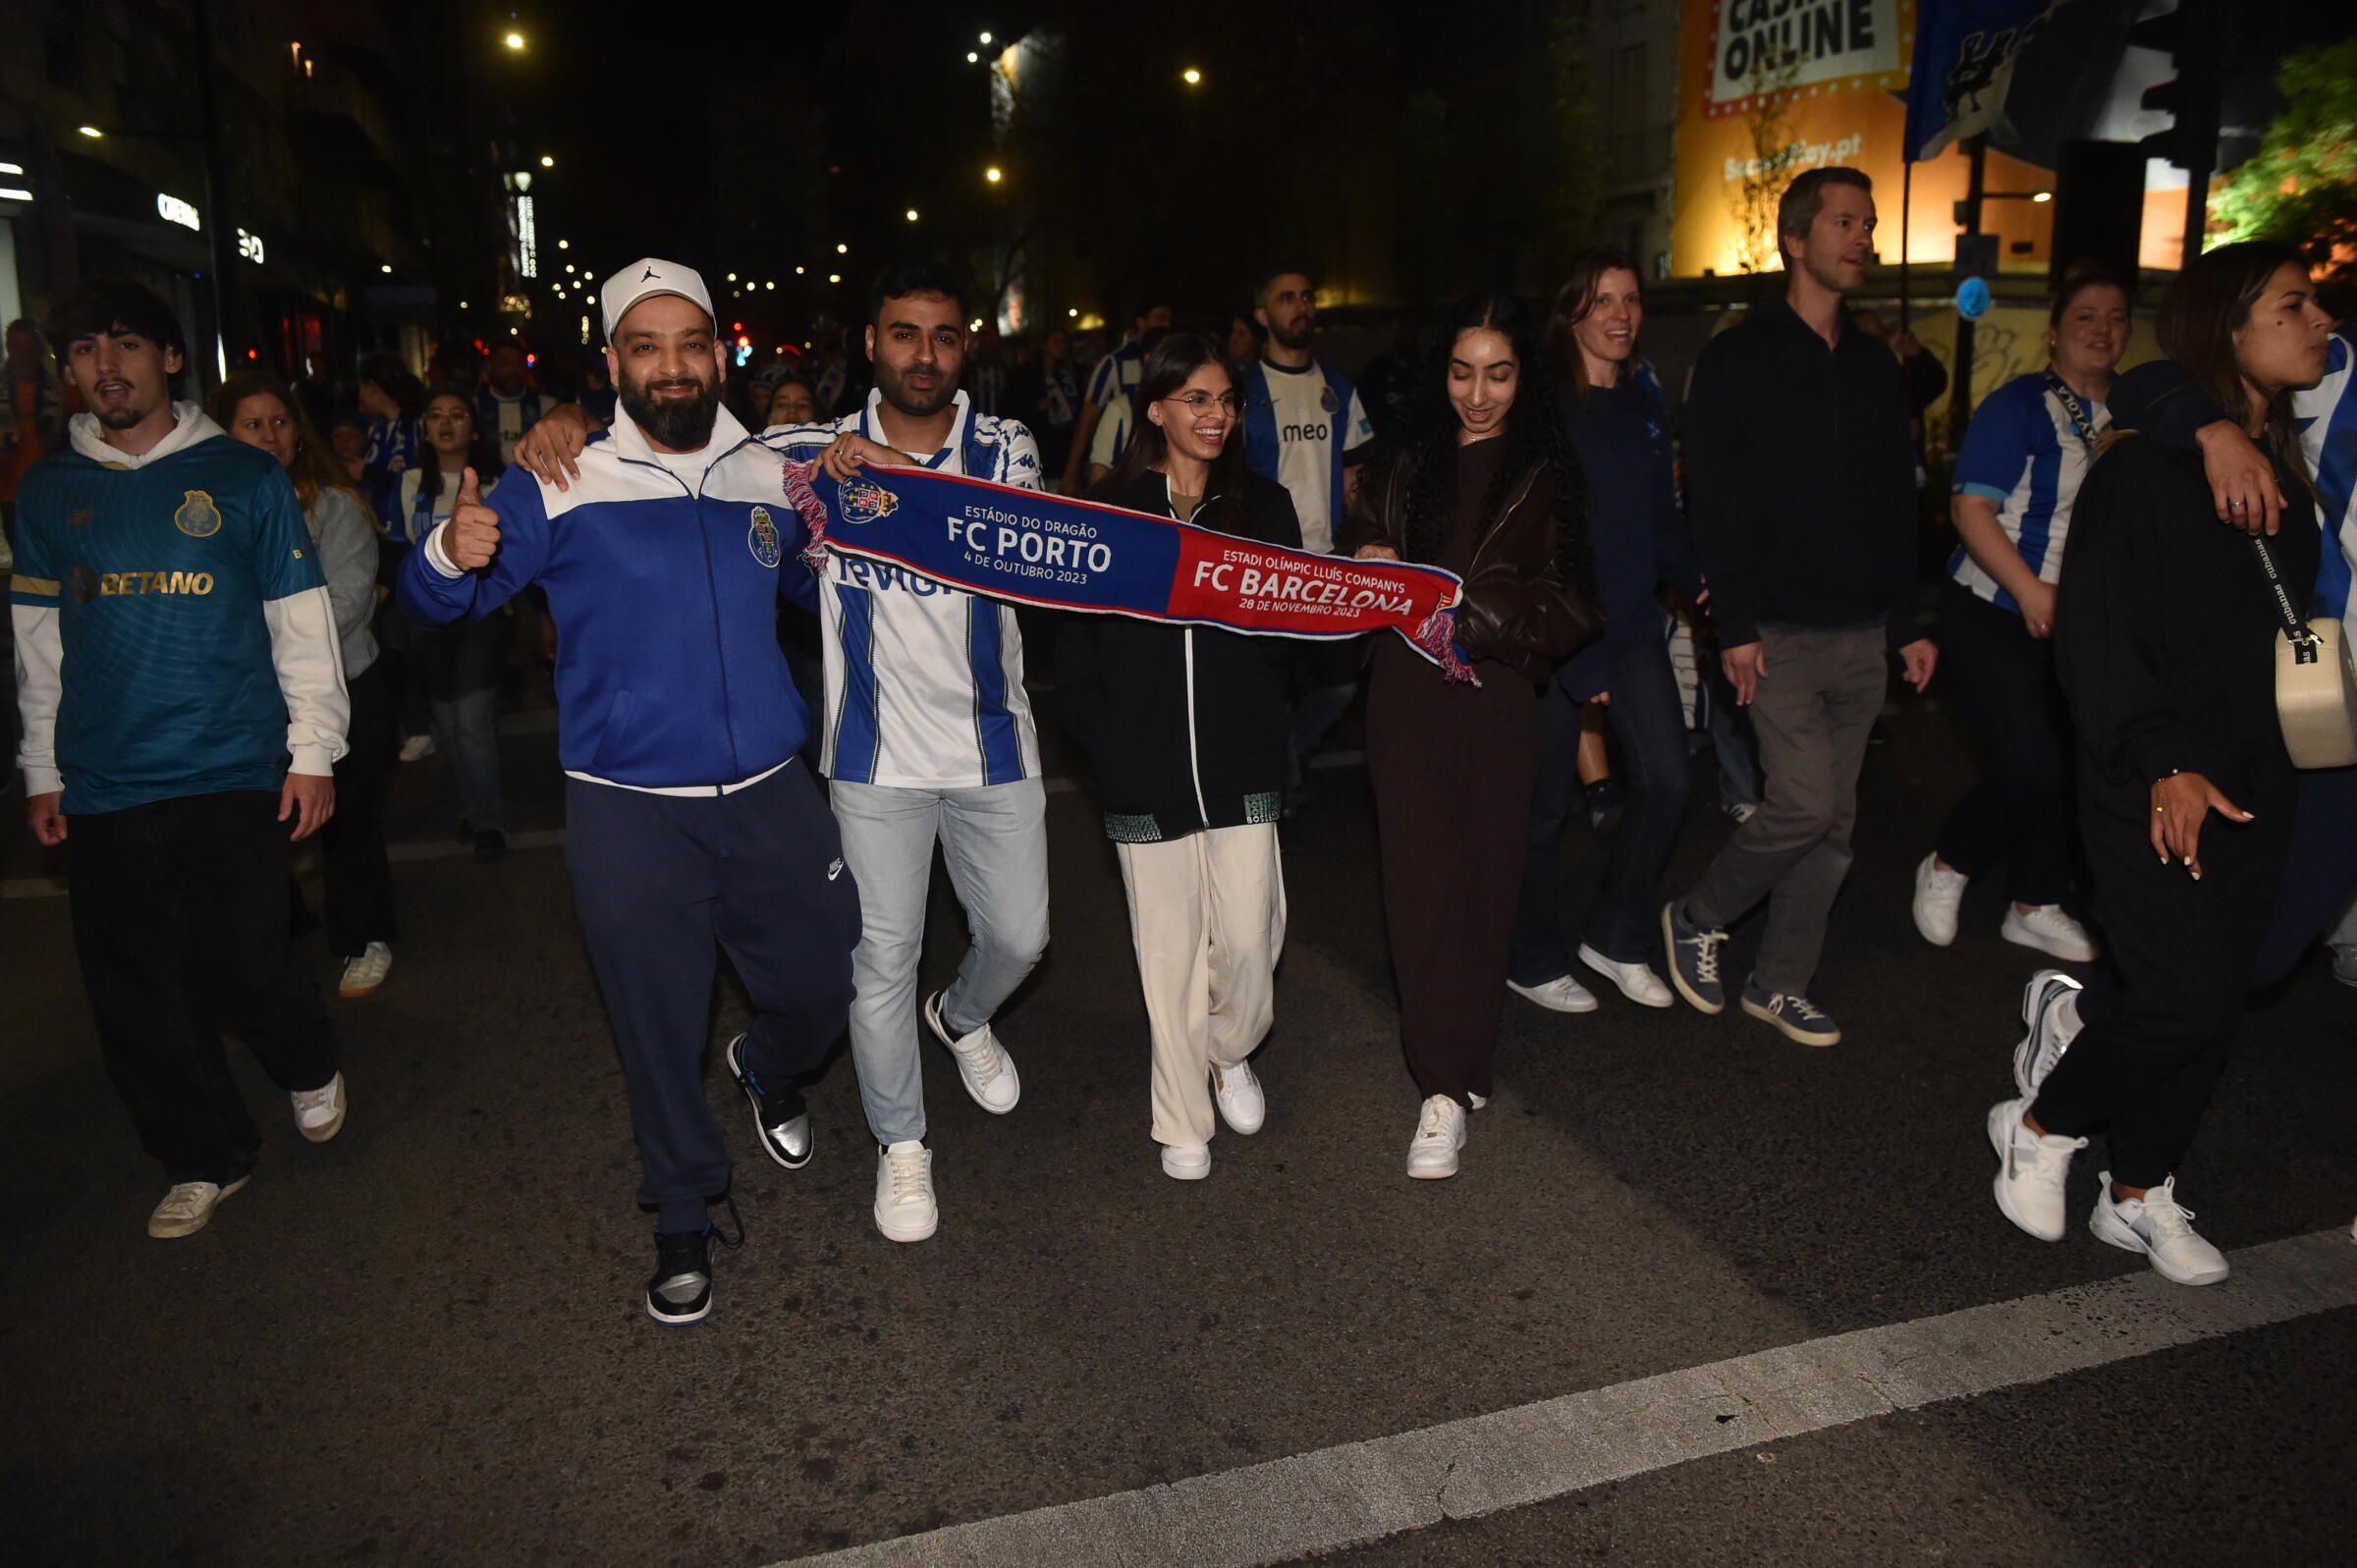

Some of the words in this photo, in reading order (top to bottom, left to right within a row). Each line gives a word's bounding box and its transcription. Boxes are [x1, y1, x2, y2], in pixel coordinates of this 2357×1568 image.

[1725, 0, 1875, 81] ONLINE
[1283, 424, 1328, 442] meo
[965, 505, 1017, 526] ESTÁDIO
[1021, 516, 1041, 530] DO
[1045, 520, 1098, 539] DRAGÃO
[947, 516, 987, 552] FC
[997, 526, 1112, 573] PORTO
[2254, 538, 2277, 580] cubanas
[100, 571, 214, 595] BETANO
[963, 551, 971, 563] 4
[974, 554, 991, 568] DE
[993, 559, 1054, 580] OUTUBRO
[1056, 569, 1087, 585] 2023
[1193, 561, 1234, 592] FC
[1238, 568, 1414, 617] BARCELONA
[1224, 549, 1263, 568] ESTADI
[1265, 555, 1312, 575] OLÍMPIC
[1313, 565, 1343, 582] LLUÍS
[1344, 572, 1406, 594] COMPANYS
[1238, 597, 1254, 610] 28
[1257, 600, 1271, 612] DE
[1271, 602, 1333, 616] NOVEMBRO
[1333, 607, 1361, 618] 2023
[2274, 583, 2297, 625] cubanas
